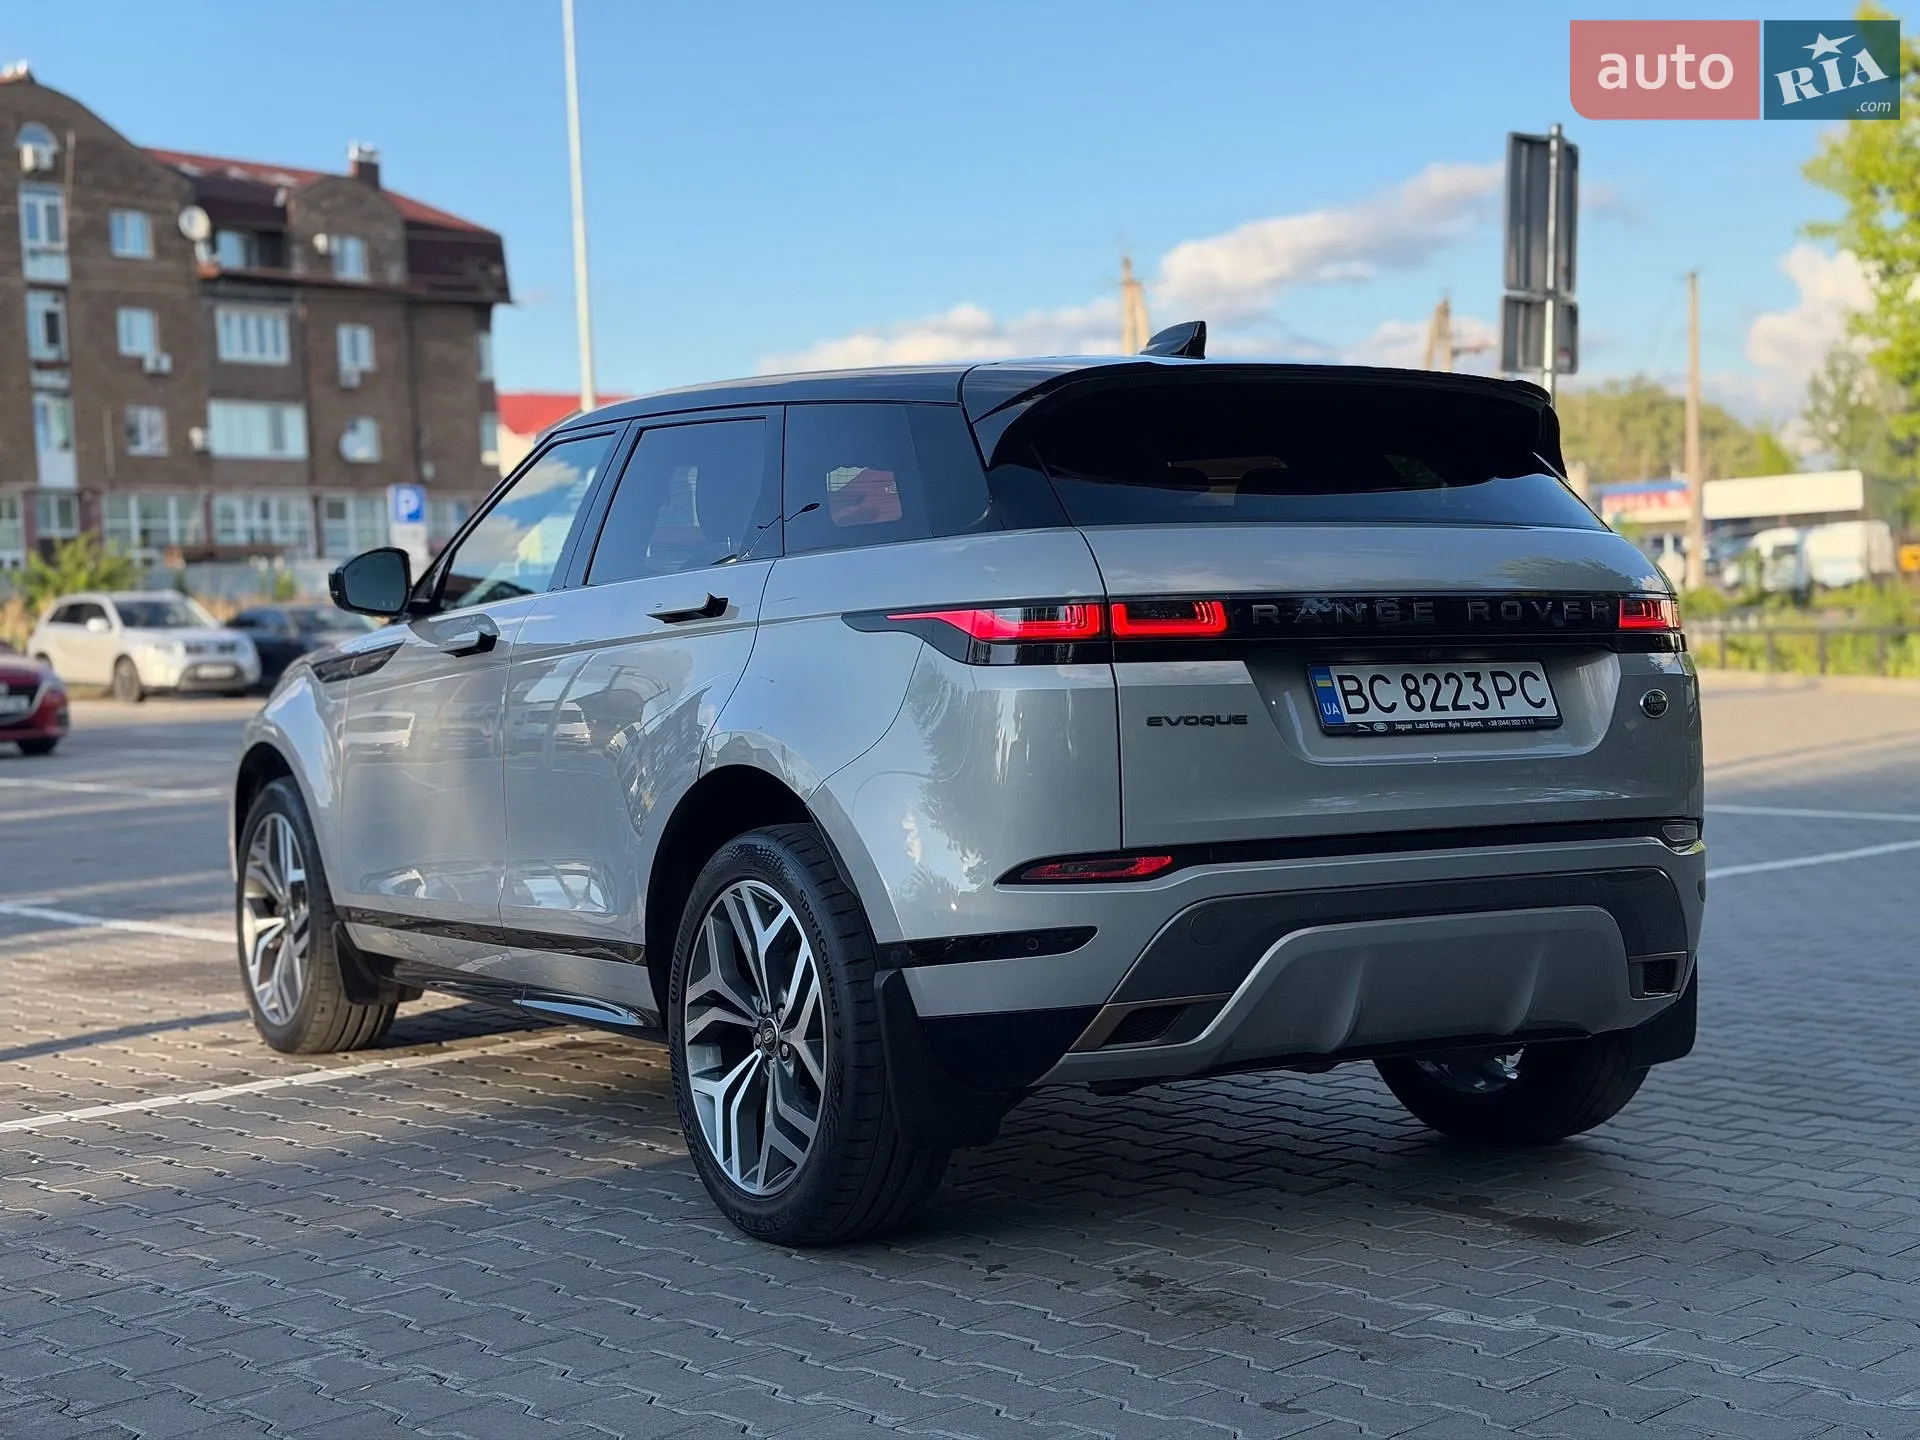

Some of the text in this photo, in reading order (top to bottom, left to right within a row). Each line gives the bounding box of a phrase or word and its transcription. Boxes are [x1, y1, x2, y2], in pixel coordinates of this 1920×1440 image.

[397, 488, 420, 521] P
[1252, 600, 1611, 625] RANGE ROVER
[1323, 702, 1341, 716] UA
[1146, 714, 1249, 727] EVOQUE
